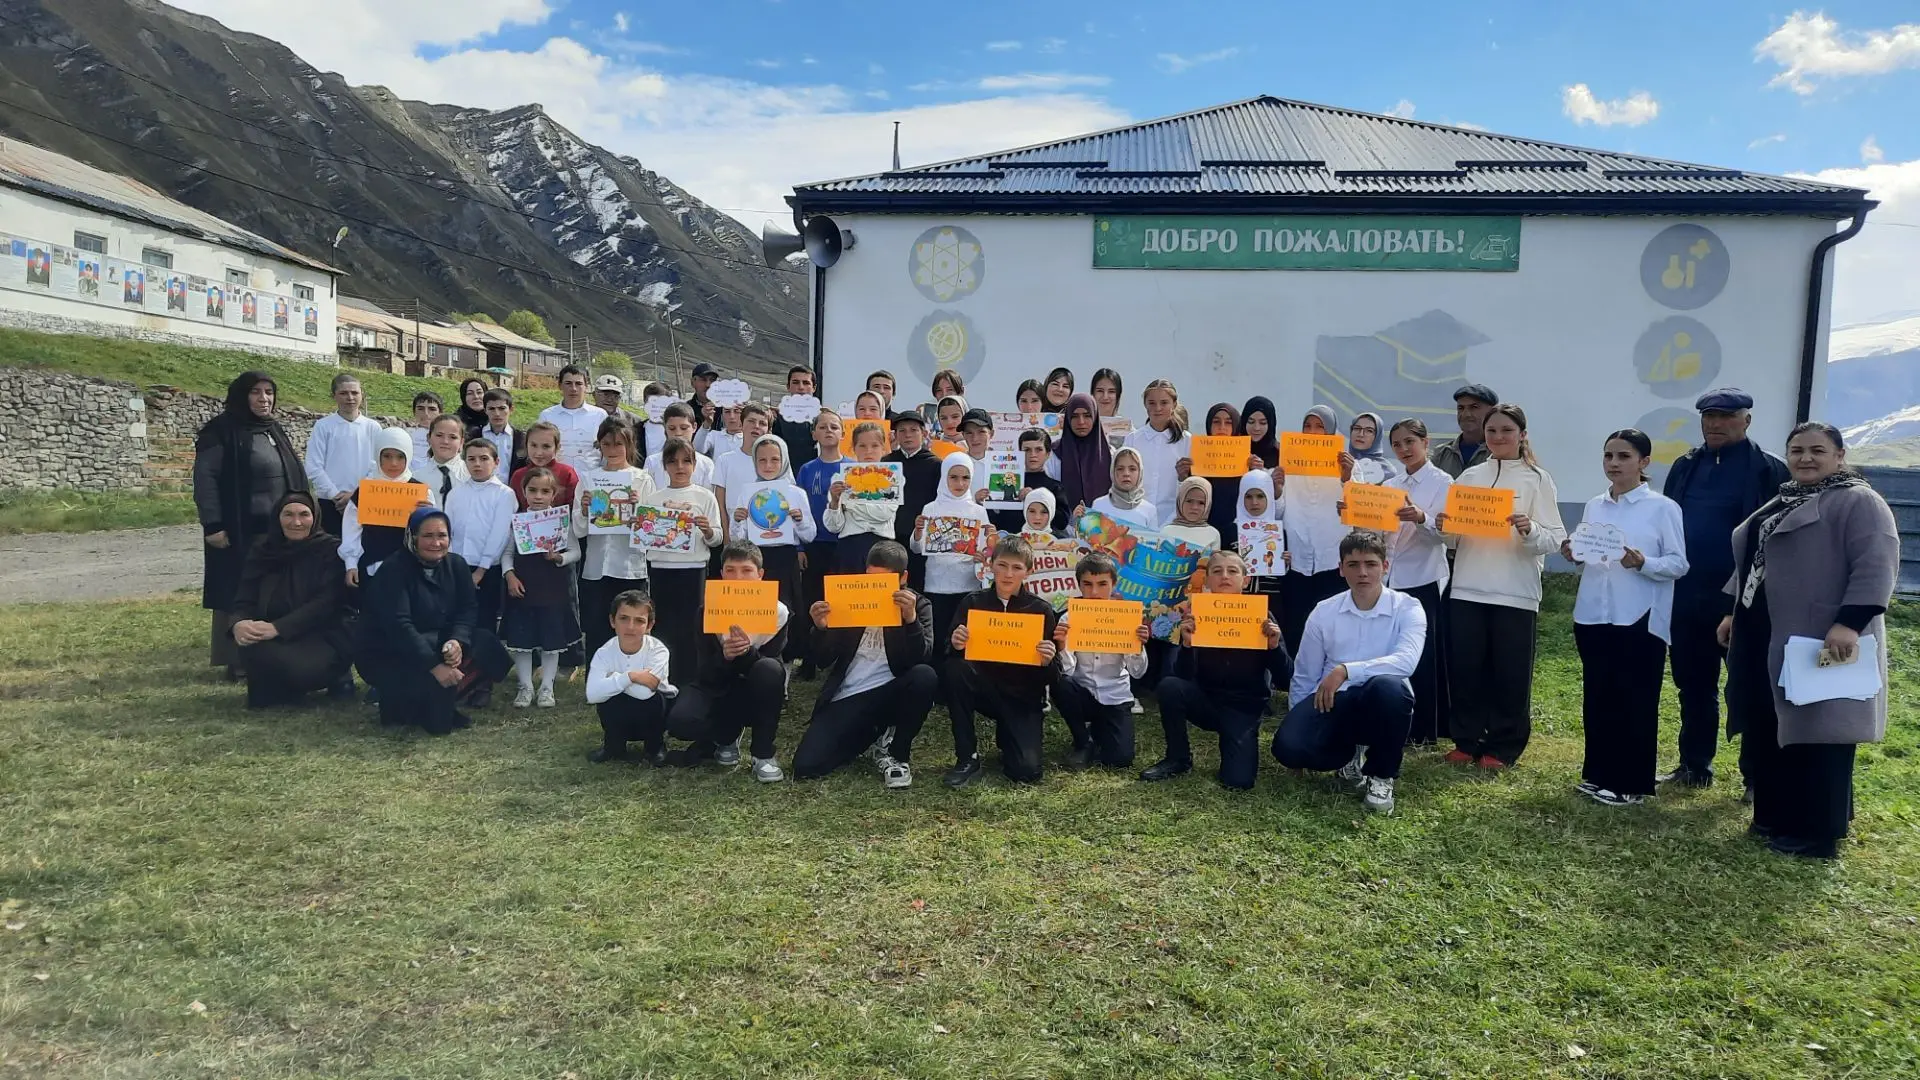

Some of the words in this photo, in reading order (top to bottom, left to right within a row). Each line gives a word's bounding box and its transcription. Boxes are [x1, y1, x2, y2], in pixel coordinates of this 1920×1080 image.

[1142, 228, 1238, 254] ДОБРО
[1254, 228, 1464, 254] ПОЖАЛОВАТЬ!
[1033, 552, 1069, 570] нём
[837, 580, 869, 590] чтобы
[872, 581, 888, 590] вы
[1026, 577, 1077, 595] теля
[1072, 604, 1140, 614] Почувствовали
[1213, 599, 1248, 610] Стали
[737, 608, 775, 616] сложно
[988, 617, 1003, 627] Но
[1007, 621, 1024, 629] мы
[1095, 616, 1115, 625] себя
[1198, 615, 1252, 625] увереннее
[1080, 627, 1130, 636] любимыми
[1217, 628, 1240, 637] себя
[1085, 640, 1132, 649] нужными
